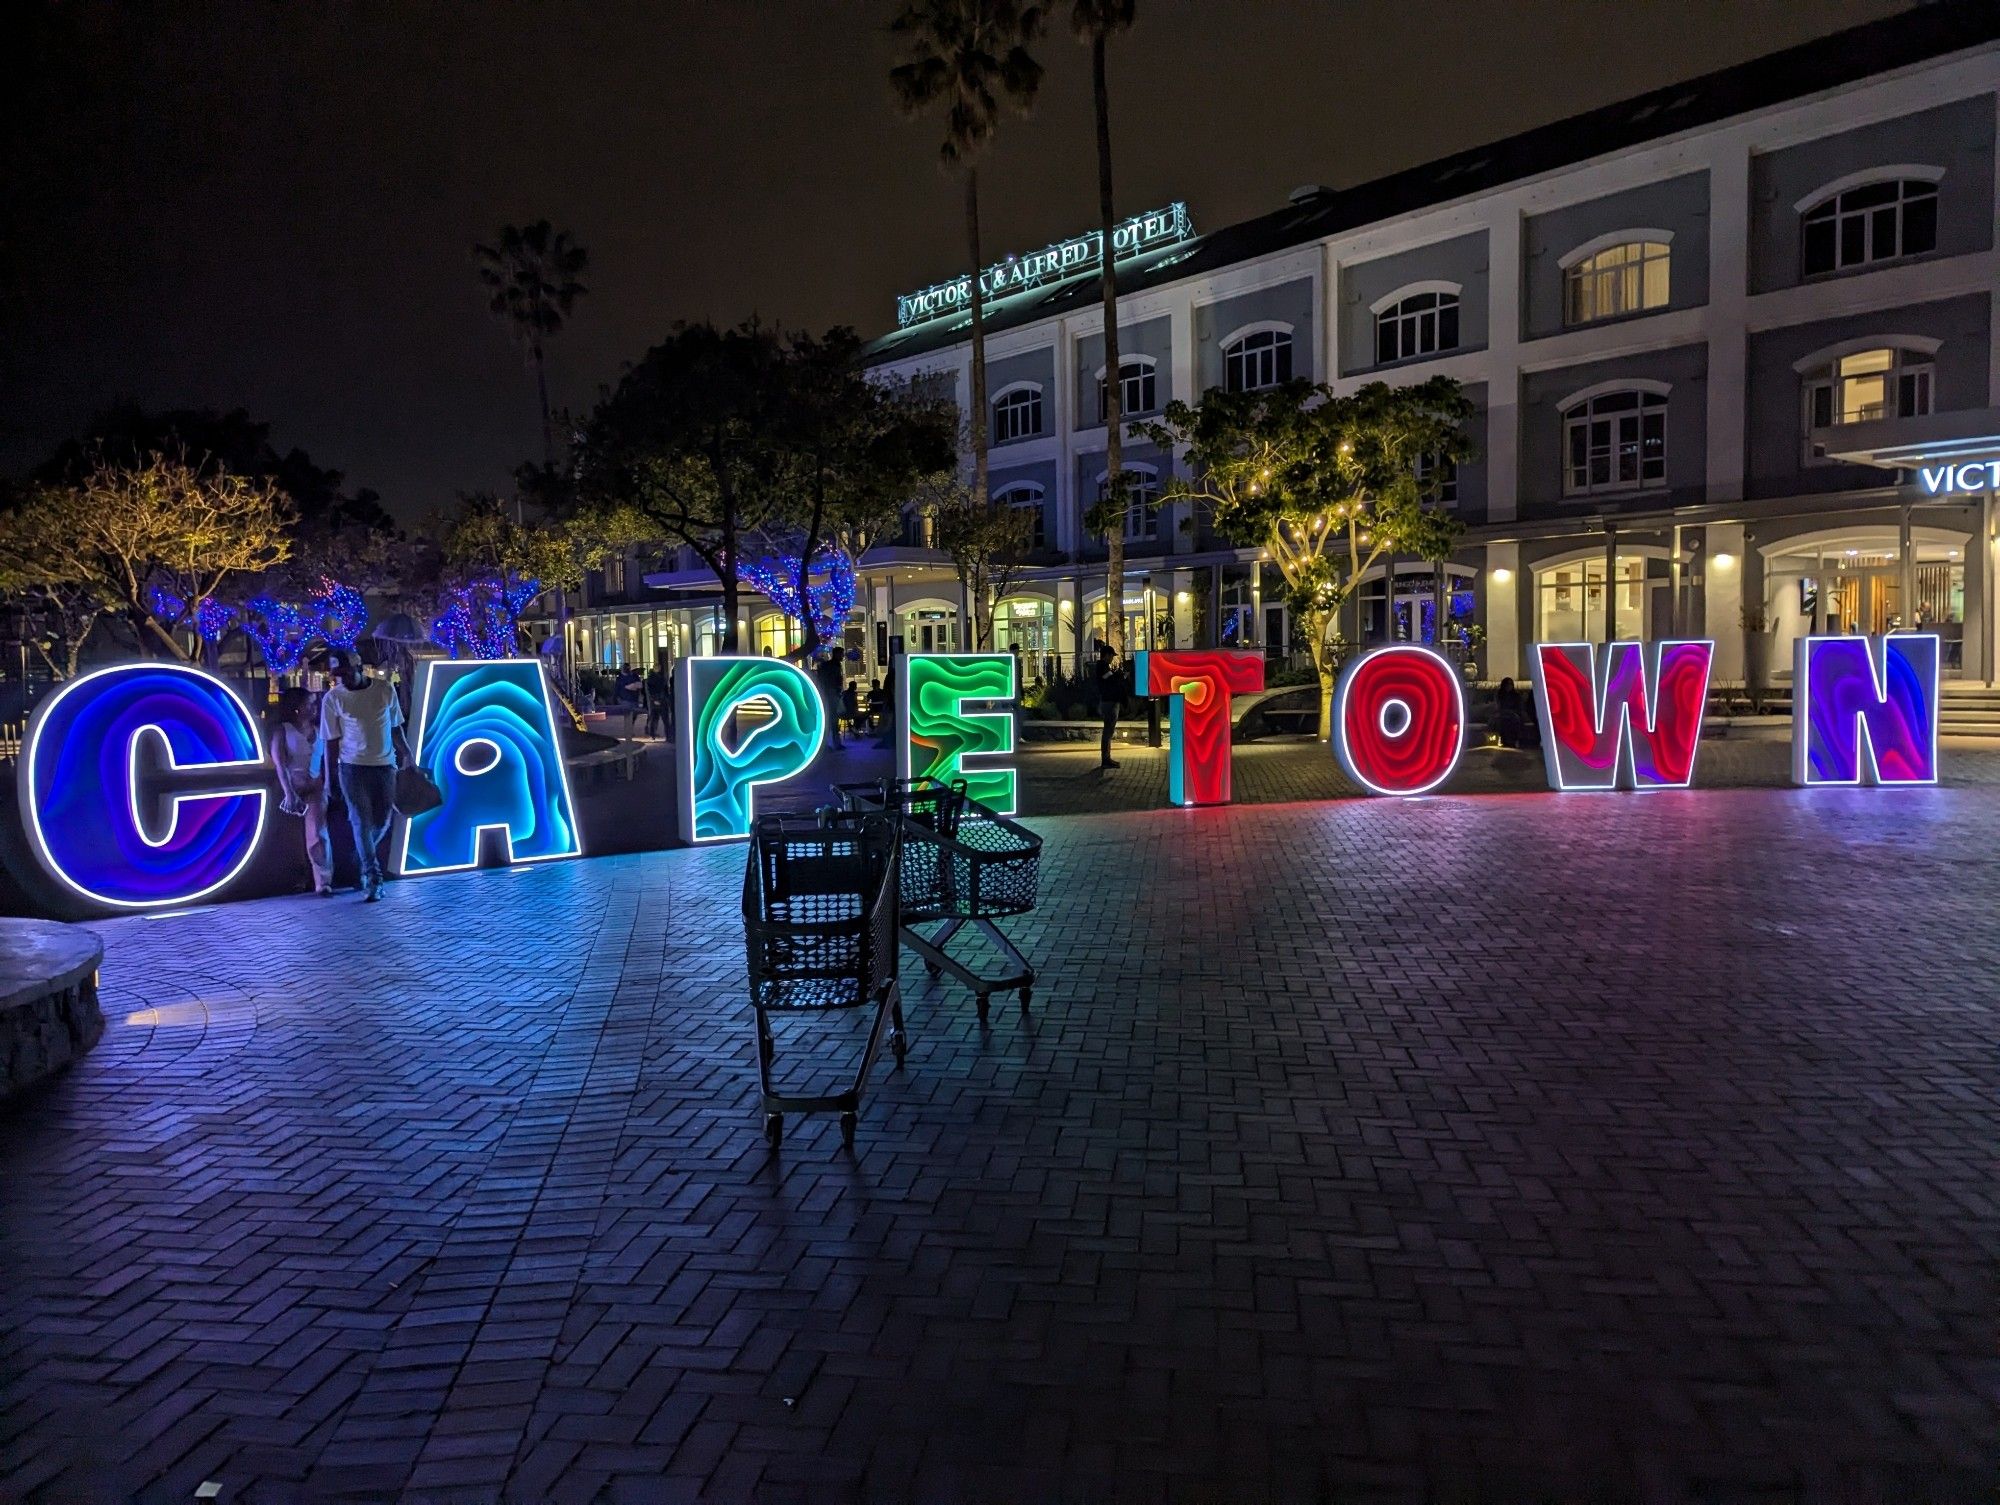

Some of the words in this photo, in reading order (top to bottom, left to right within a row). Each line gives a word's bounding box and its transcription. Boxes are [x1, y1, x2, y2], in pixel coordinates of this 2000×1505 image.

[907, 276, 988, 314] VICTORA
[993, 269, 1006, 289] &
[1010, 242, 1089, 284] ALFRED
